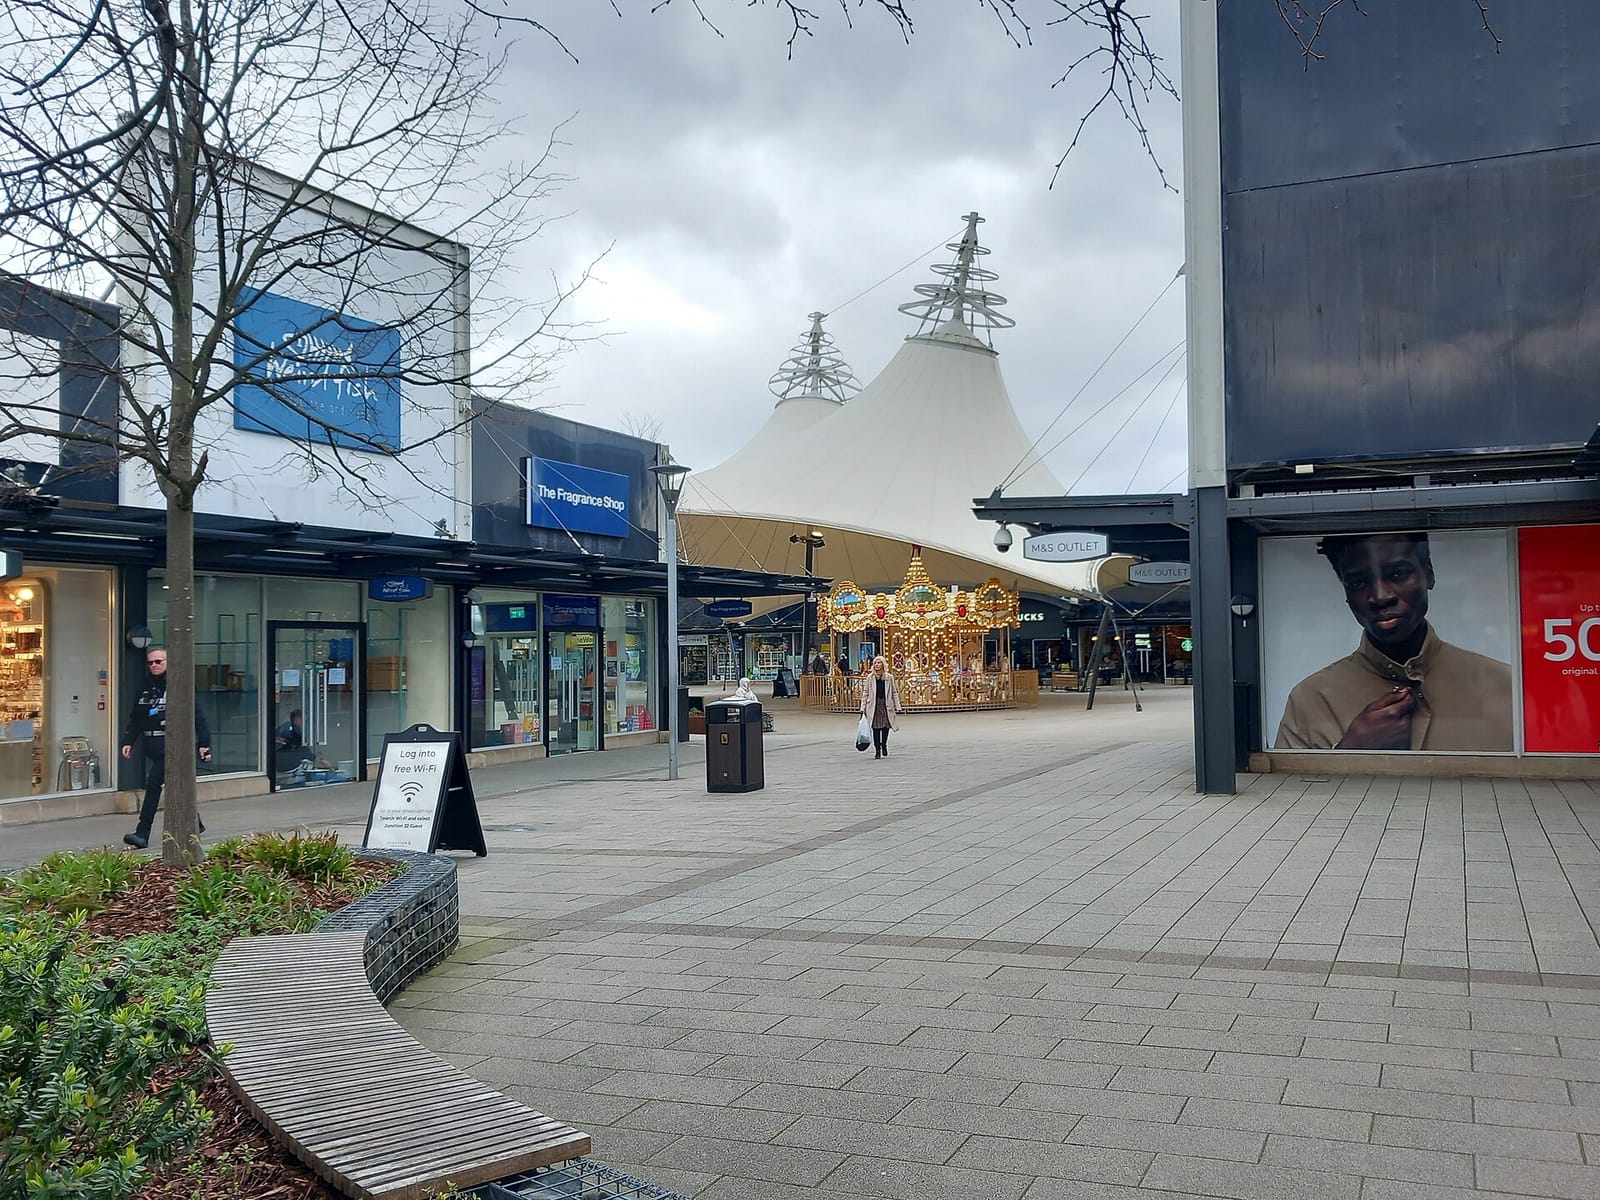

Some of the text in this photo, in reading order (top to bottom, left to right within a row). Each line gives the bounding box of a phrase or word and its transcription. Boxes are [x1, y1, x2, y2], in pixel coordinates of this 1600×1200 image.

[537, 484, 625, 513] The Fragrance Shop
[1031, 541, 1100, 553] M&S OUTLET
[1134, 568, 1188, 577] M&S OUTLET
[1580, 604, 1600, 613] Up t
[1016, 612, 1045, 622] UCKS
[1544, 617, 1600, 662] 50
[1562, 667, 1598, 677] original
[400, 749, 436, 760] Log into
[393, 764, 437, 774] free Wi-Fi
